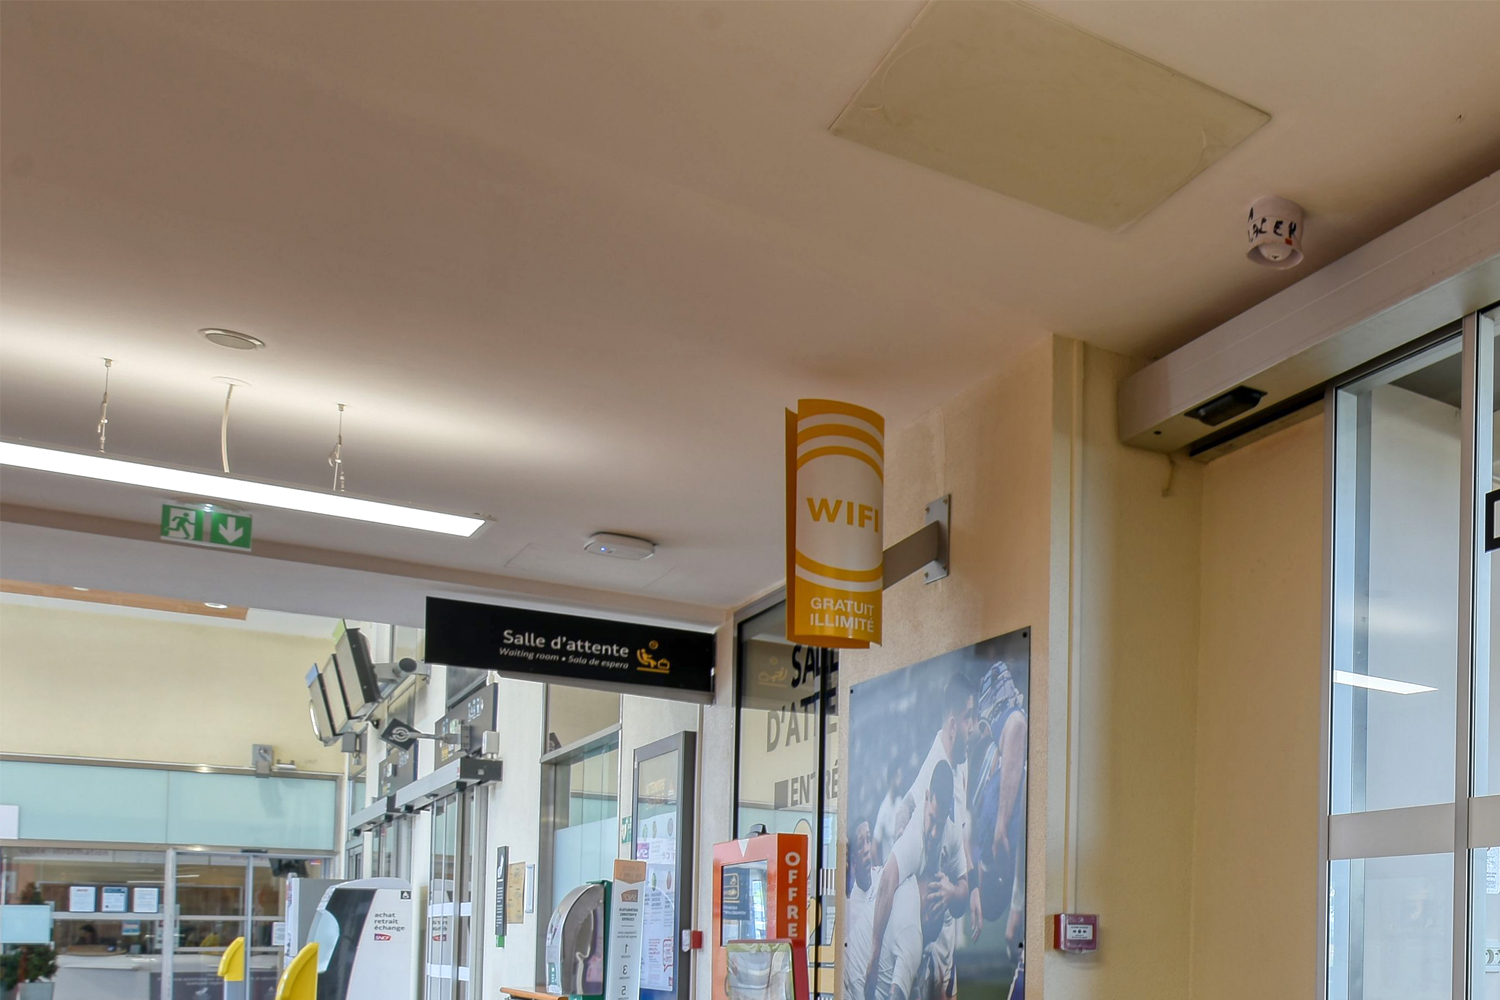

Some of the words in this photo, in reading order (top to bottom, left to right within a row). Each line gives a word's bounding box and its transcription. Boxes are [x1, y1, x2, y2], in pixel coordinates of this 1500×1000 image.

[806, 497, 879, 533] WIFI
[810, 597, 875, 616] GRATUIT
[810, 613, 875, 633] ILLIMITÉ
[503, 629, 545, 648] Salle
[550, 631, 629, 657] d'attente
[499, 647, 535, 661] Waiting
[535, 652, 560, 662] room
[568, 654, 588, 666] Sala
[588, 657, 601, 667] de
[601, 659, 629, 670] espera
[785, 851, 801, 938] OFFRE
